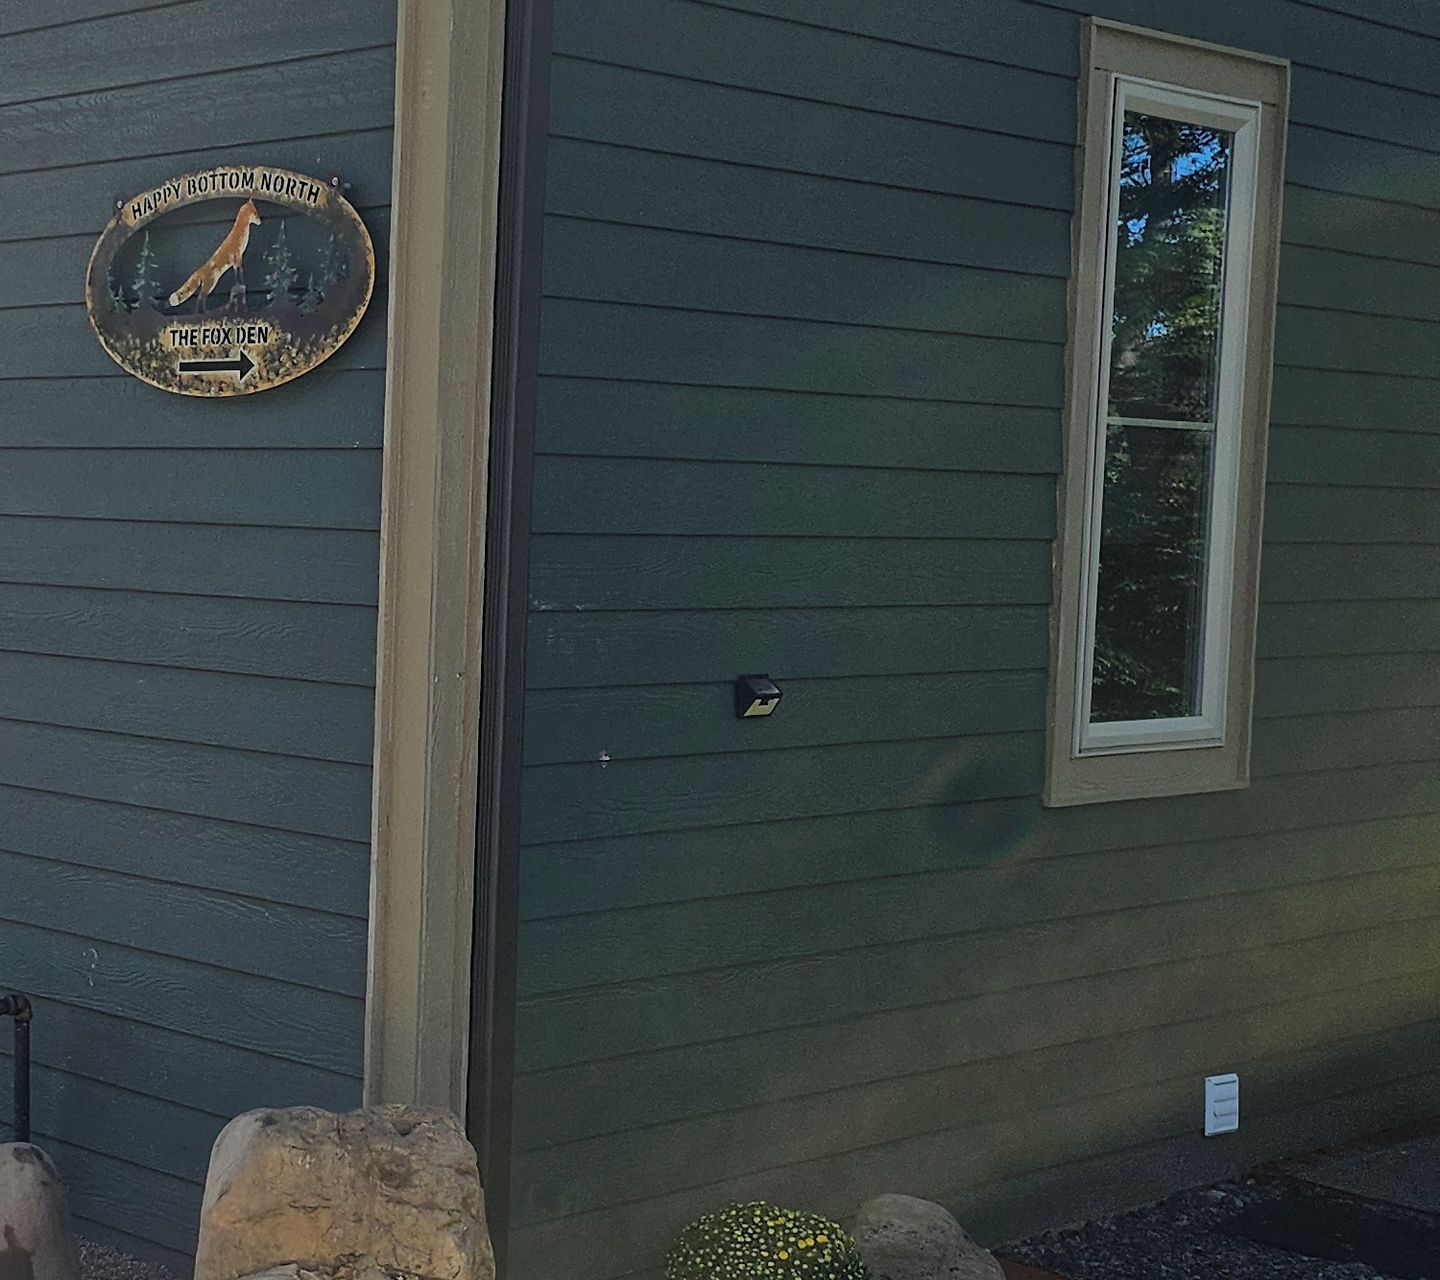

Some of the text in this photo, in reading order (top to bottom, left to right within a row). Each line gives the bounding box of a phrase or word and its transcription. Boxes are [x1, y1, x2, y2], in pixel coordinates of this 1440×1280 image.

[130, 172, 322, 221] HAPPY BOTTOM NORTH
[169, 326, 270, 347] THE FOX DEN
